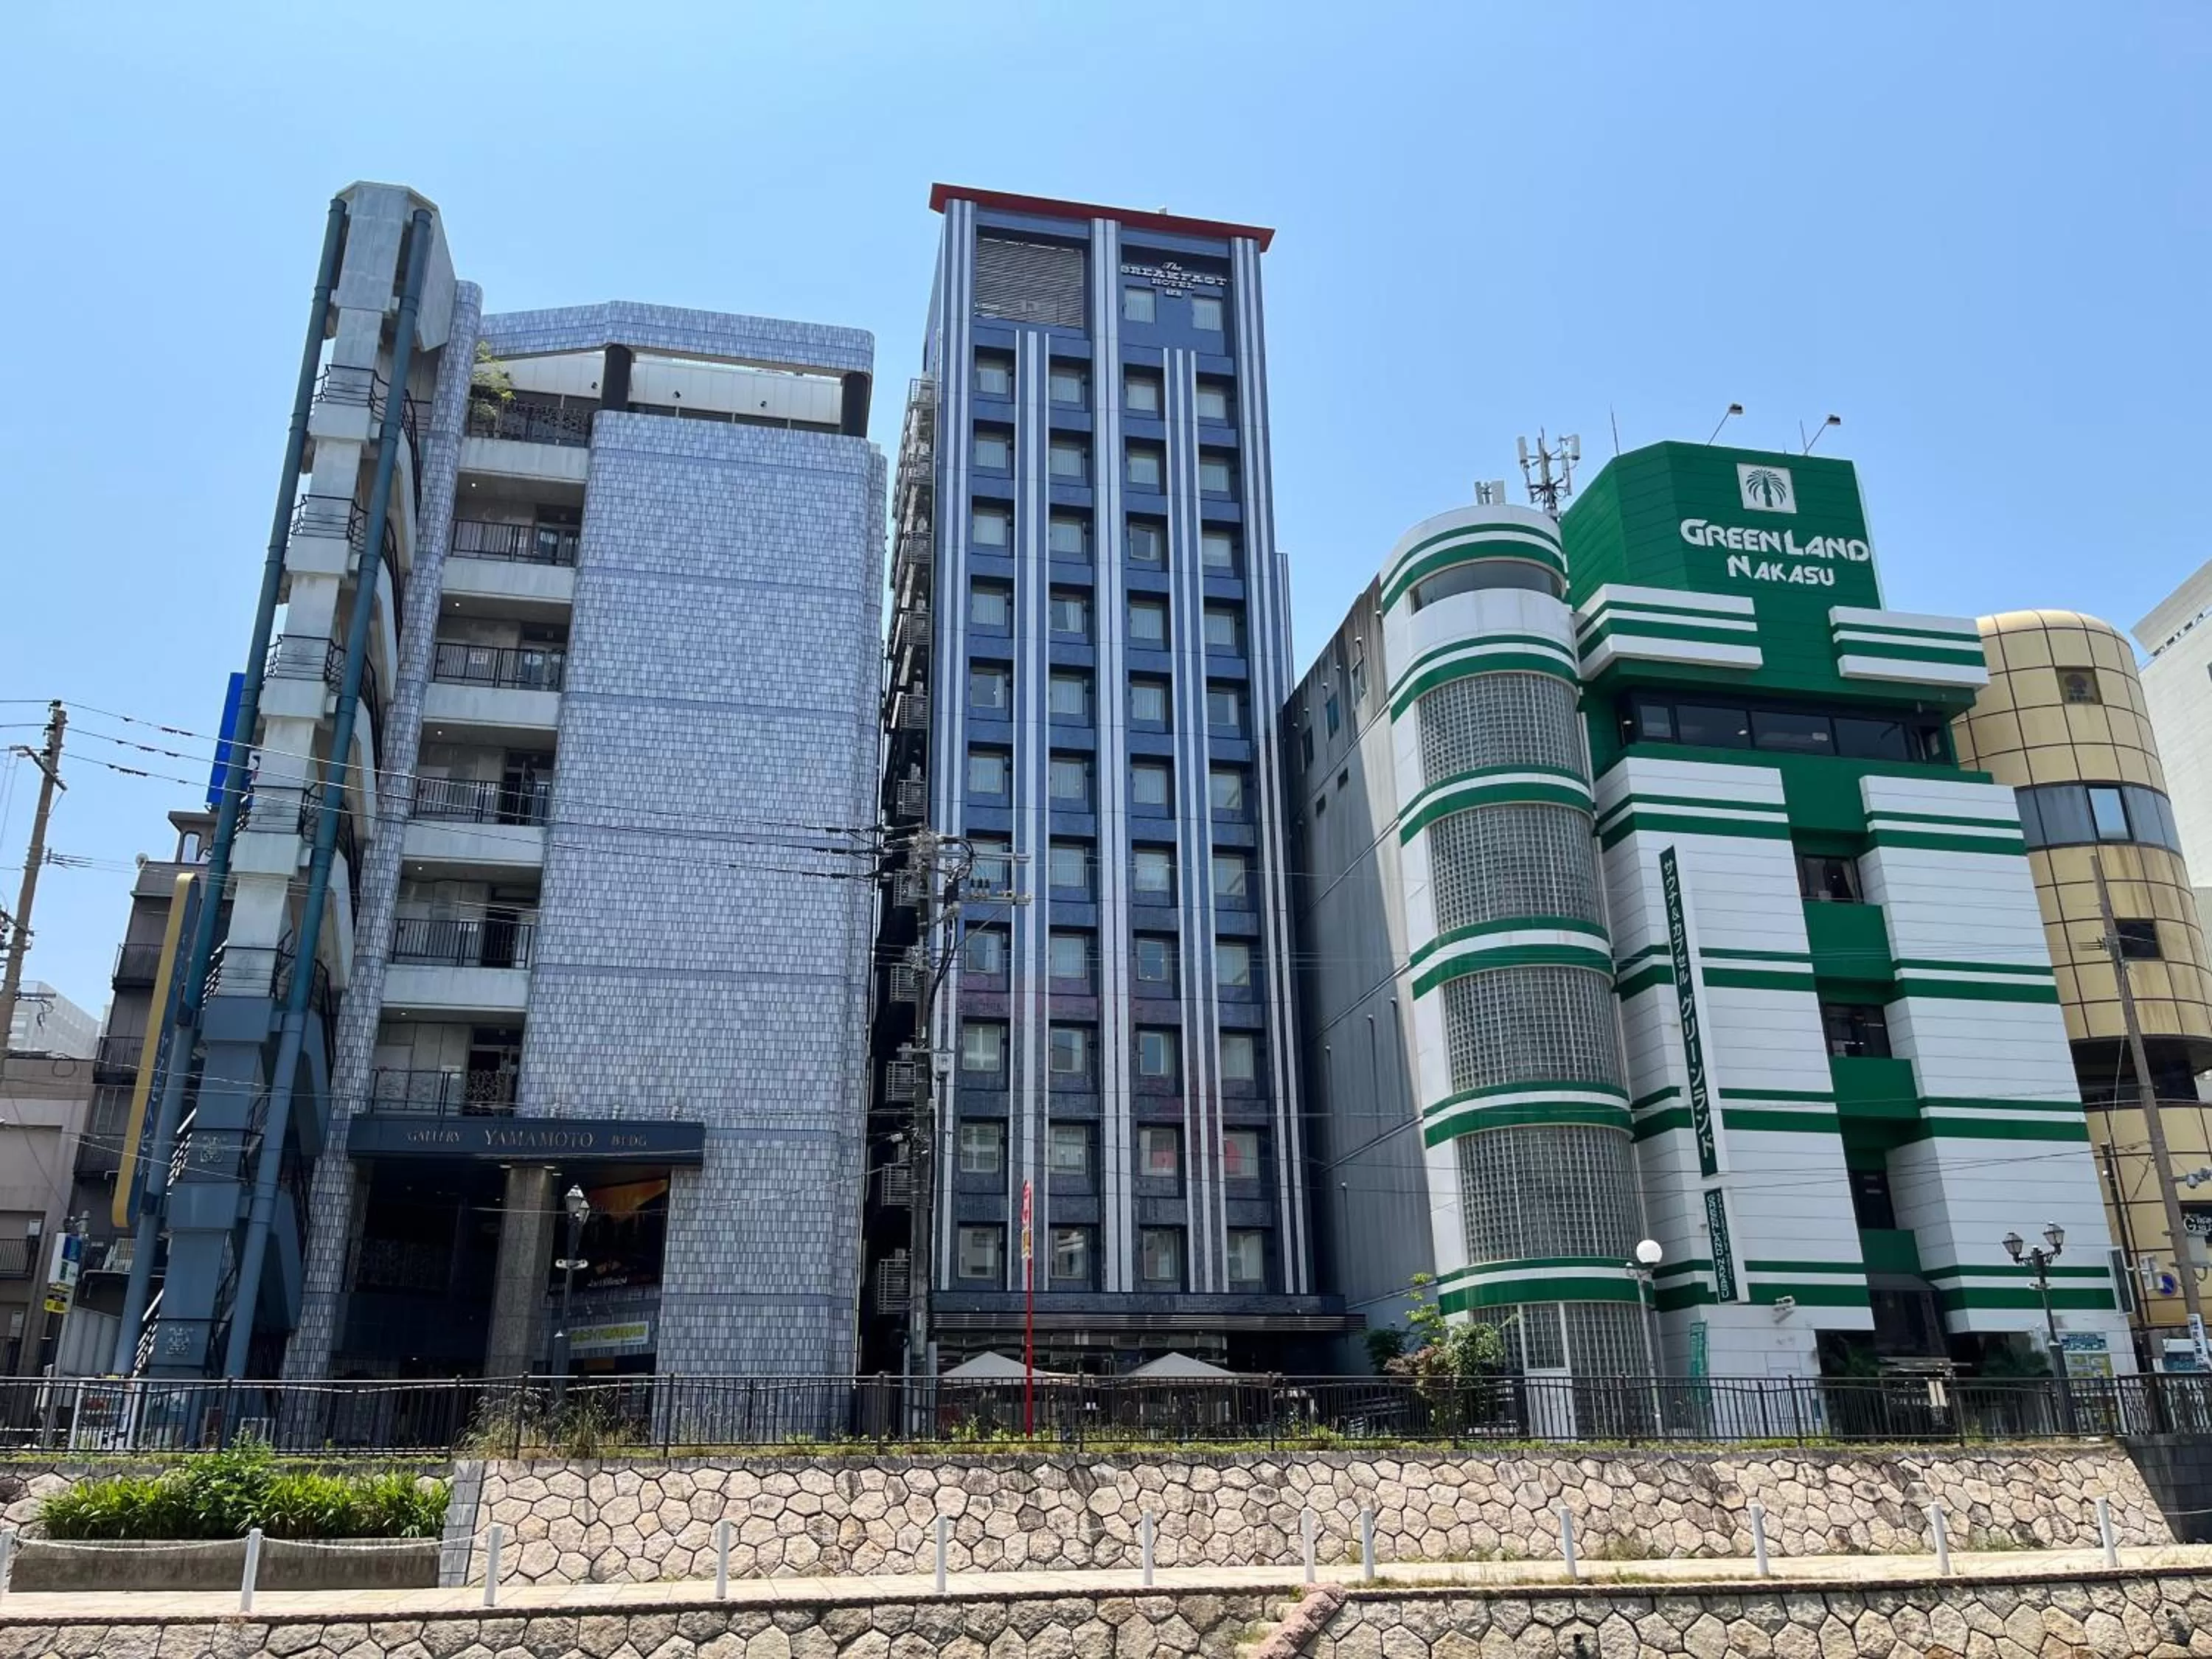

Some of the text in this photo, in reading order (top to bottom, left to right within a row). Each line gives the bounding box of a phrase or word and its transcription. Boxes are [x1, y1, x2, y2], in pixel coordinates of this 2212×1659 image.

[1151, 276, 1194, 289] HOTEL
[1727, 554, 1834, 586] NAKASU
[1680, 993, 1713, 1158] グリーンランド
[407, 1130, 461, 1142] GALLERY
[484, 1129, 596, 1148] YAMAMOTO
